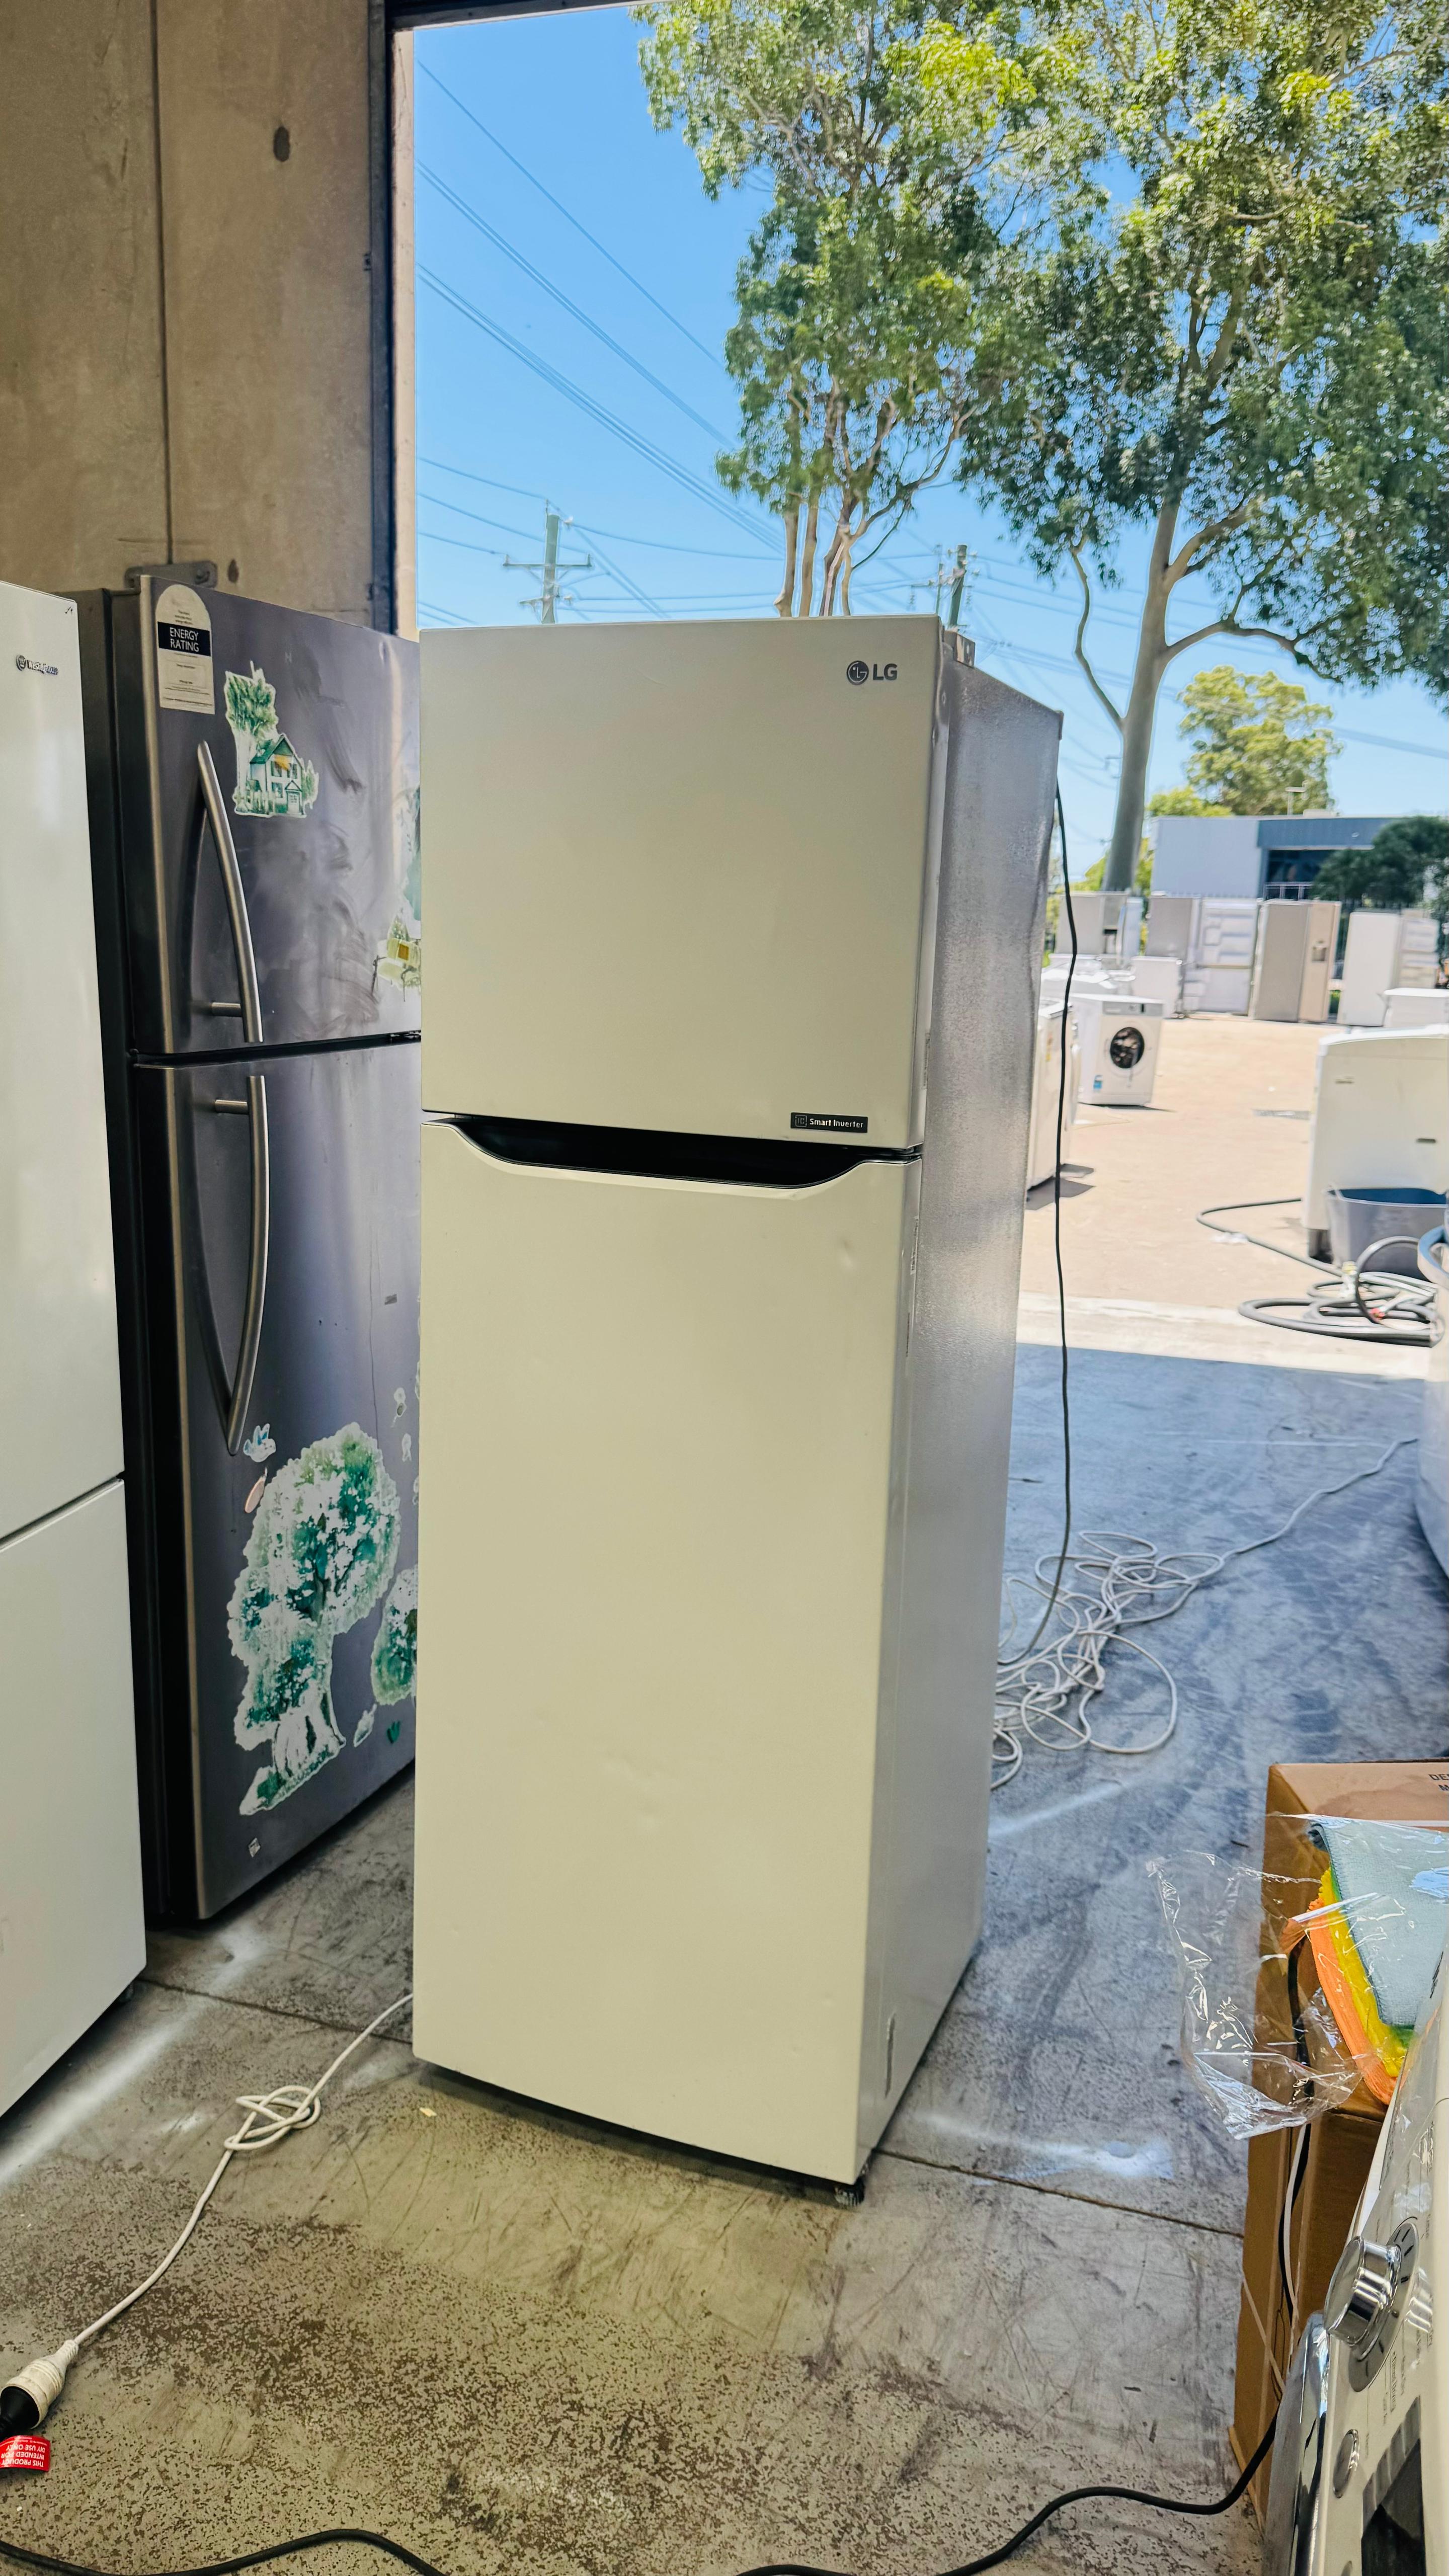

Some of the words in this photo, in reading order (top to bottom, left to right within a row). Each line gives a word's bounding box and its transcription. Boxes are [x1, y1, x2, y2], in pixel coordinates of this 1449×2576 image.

[170, 627, 198, 641] ENERGY
[170, 638, 199, 652] RATING
[873, 663, 898, 680] LG
[833, 1119, 863, 1128] Inverter
[16, 2451, 44, 2460] INTENDED
